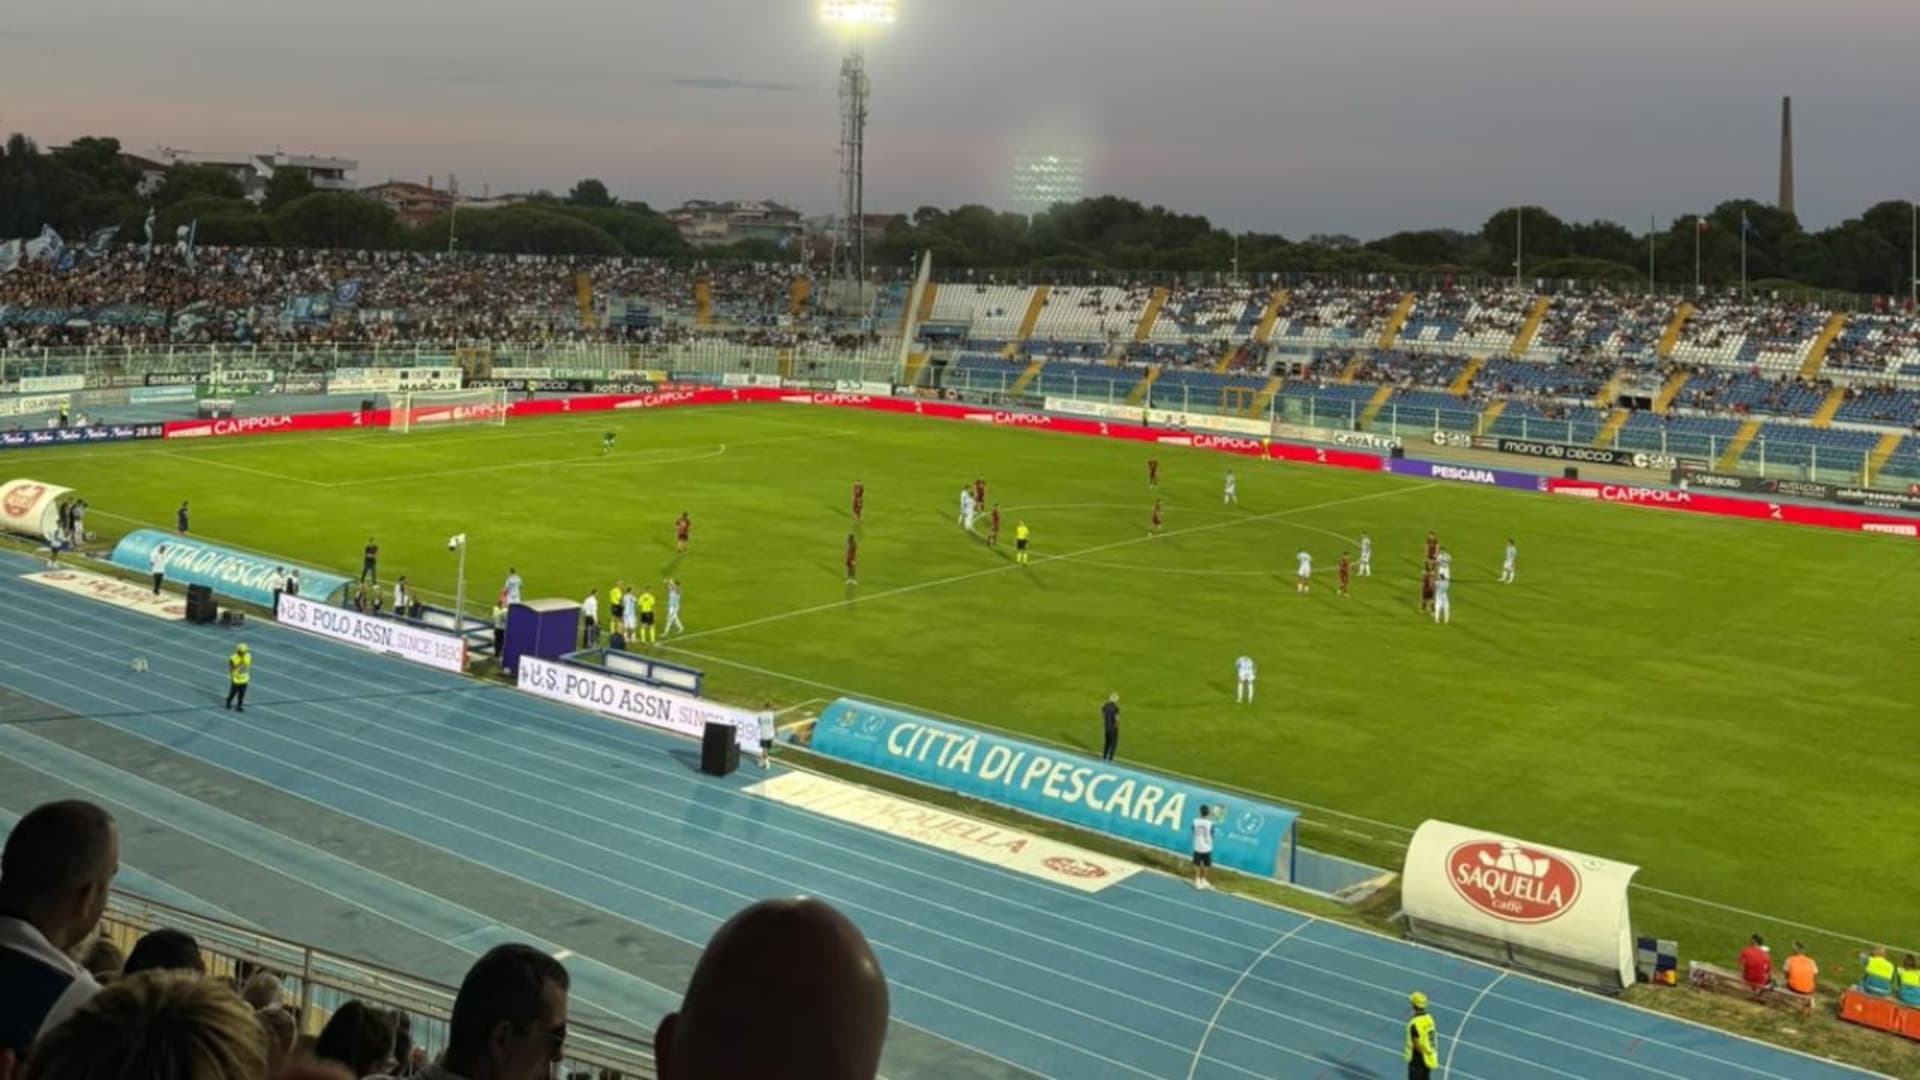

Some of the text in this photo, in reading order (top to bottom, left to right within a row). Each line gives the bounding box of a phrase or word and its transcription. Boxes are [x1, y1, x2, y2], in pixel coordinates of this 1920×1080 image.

[213, 415, 293, 434] CAPPOLA
[995, 411, 1051, 424] CAPPOLA
[1193, 434, 1260, 449] CAPPOLA
[1432, 464, 1496, 484] PESCARA
[1602, 485, 1691, 503] CAPPOLA
[312, 608, 350, 634] POLO
[353, 619, 394, 648] ASSN.
[397, 632, 432, 654] SINCE
[530, 661, 560, 690] U.S.
[565, 674, 615, 706] POLO
[619, 689, 675, 723] ASSN.
[977, 744, 1026, 786] DI
[1020, 754, 1187, 832] PESCARA
[1457, 862, 1563, 909] SAQUELLA
